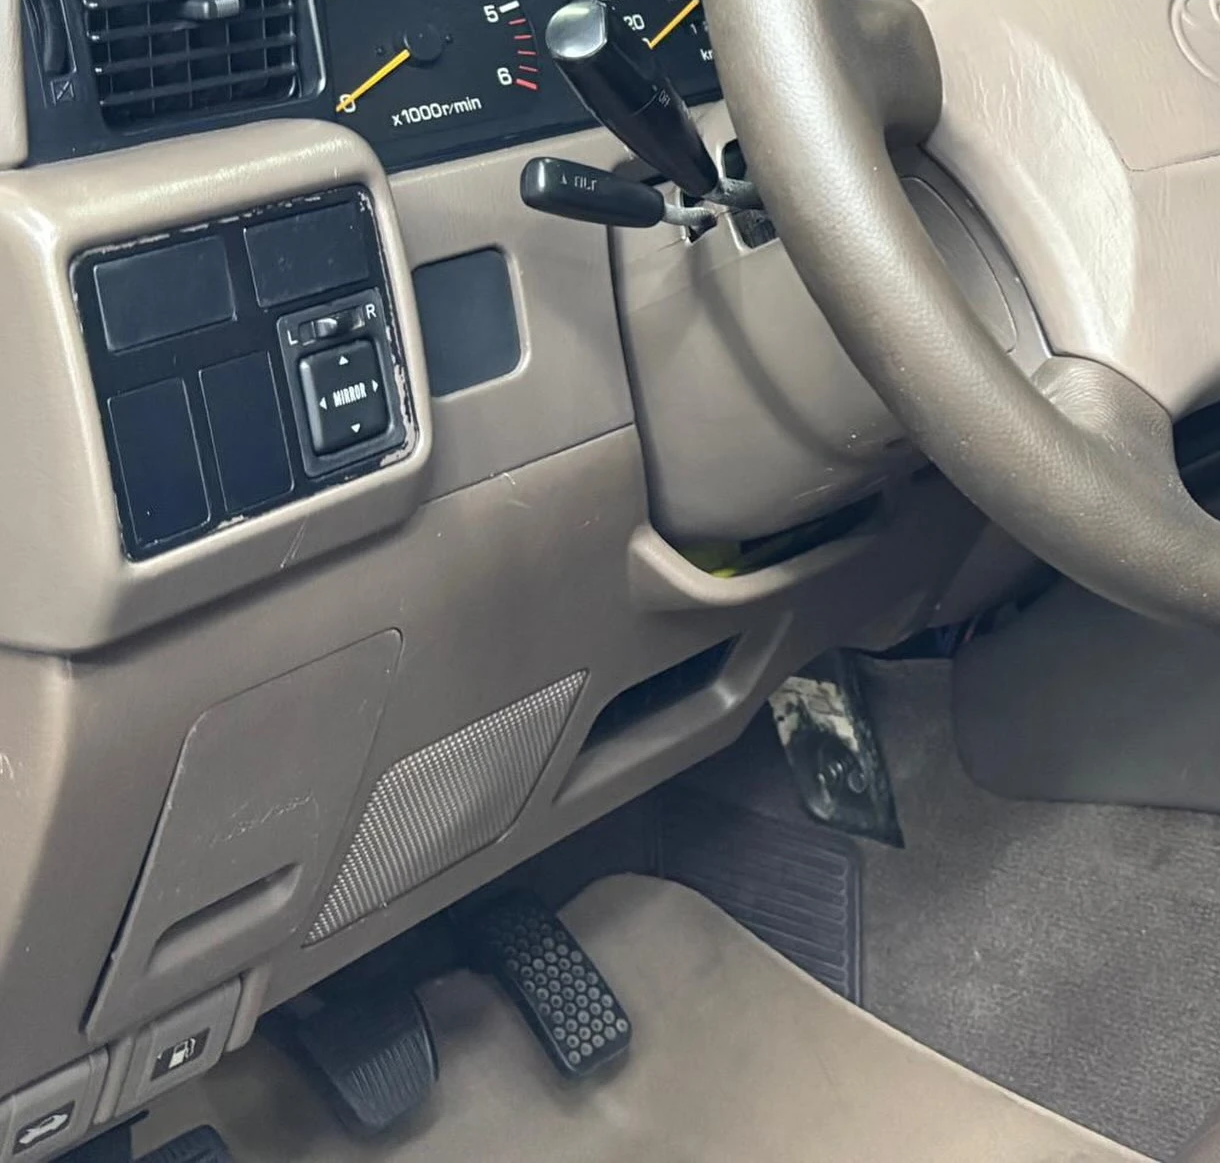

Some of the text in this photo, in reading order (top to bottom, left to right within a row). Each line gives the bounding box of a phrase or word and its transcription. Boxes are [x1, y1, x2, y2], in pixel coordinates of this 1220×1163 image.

[483, 4, 499, 22] 5
[497, 67, 512, 85] 6
[391, 96, 482, 127] x1000r/min
[365, 303, 377, 320] R
[287, 329, 299, 346] L
[332, 382, 367, 408] MIRROR
